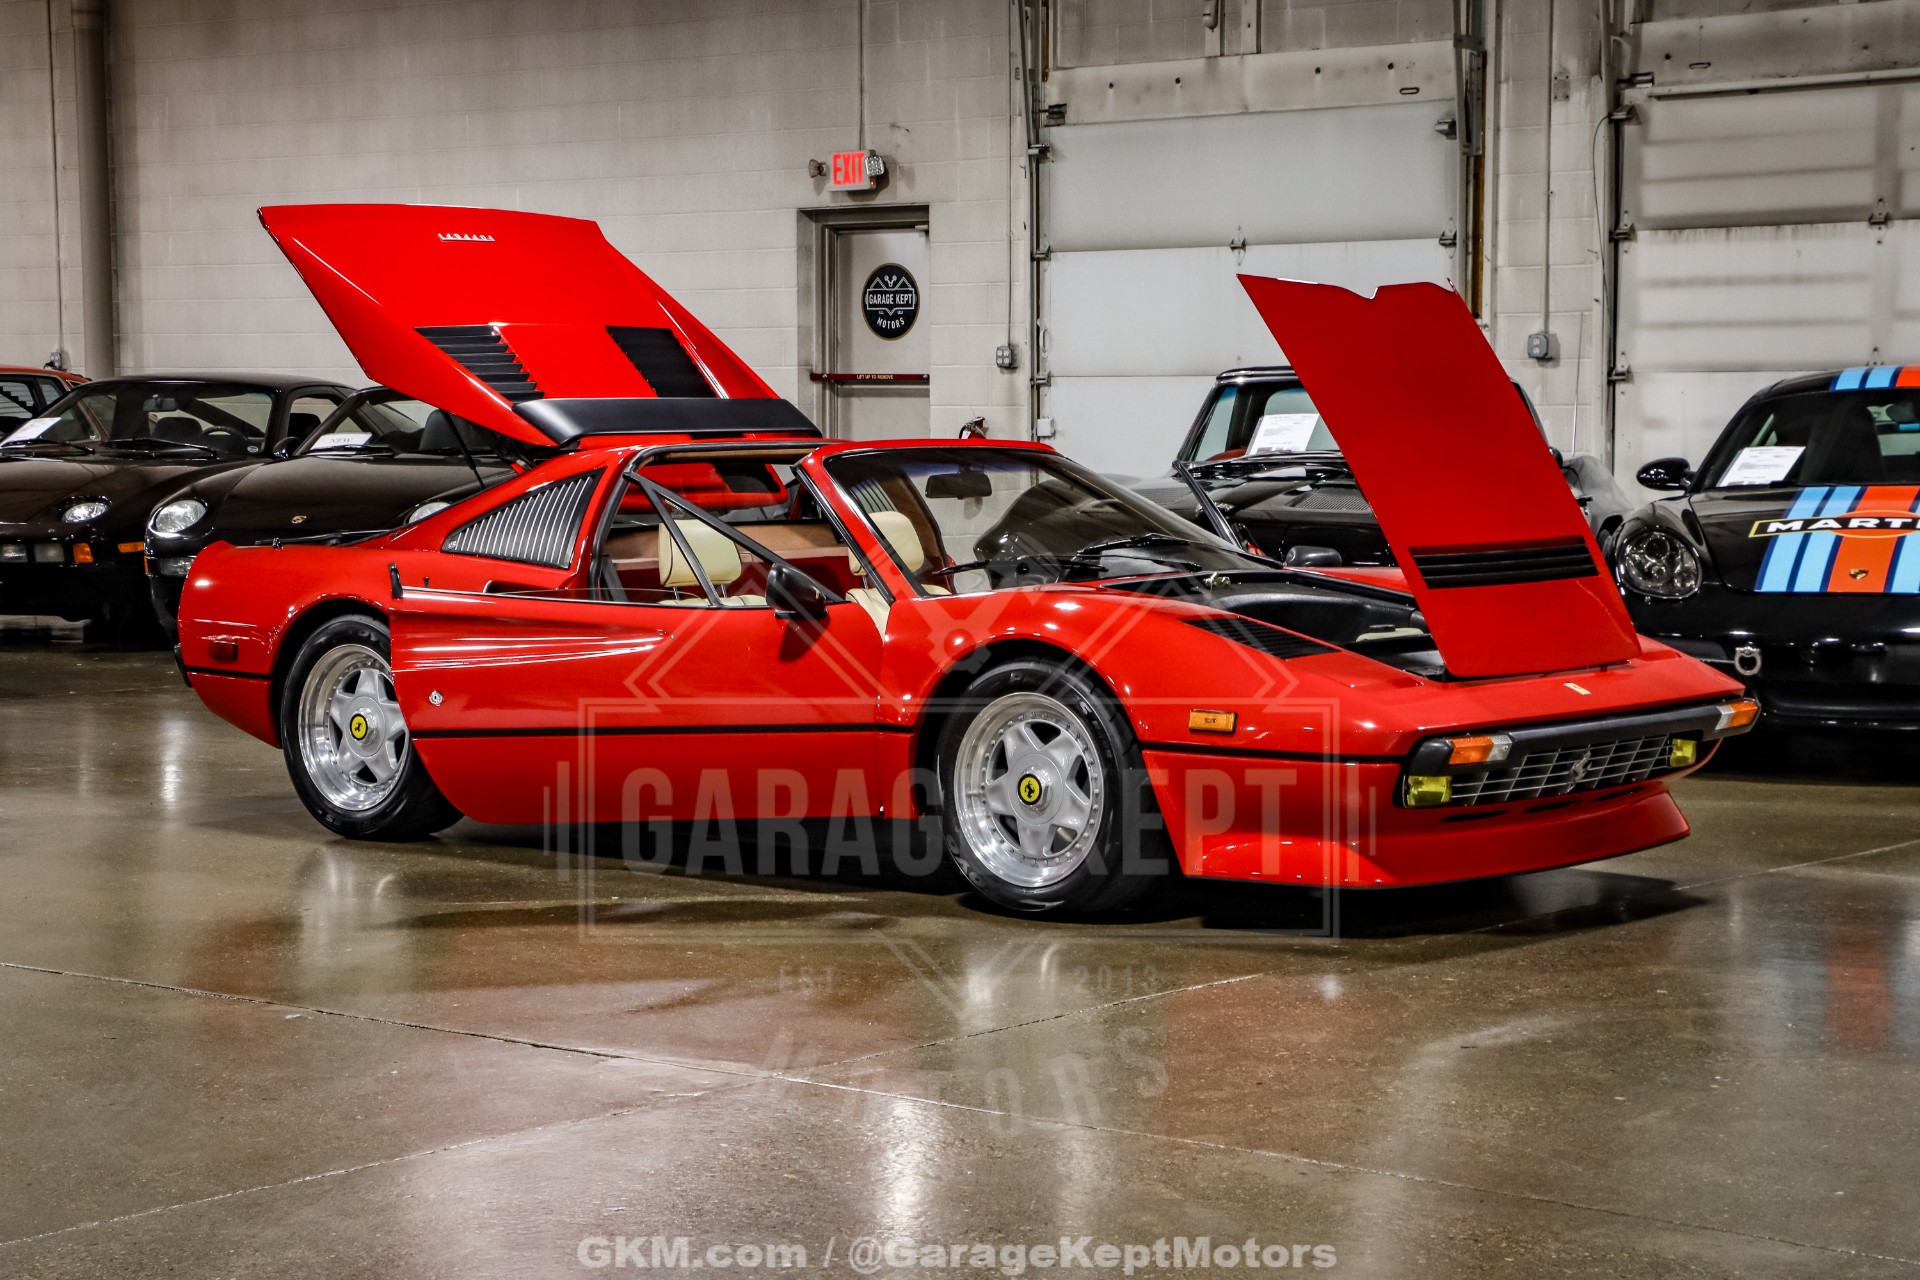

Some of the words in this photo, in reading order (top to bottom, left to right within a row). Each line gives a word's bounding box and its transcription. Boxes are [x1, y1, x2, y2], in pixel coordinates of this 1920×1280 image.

[832, 151, 865, 185] EXIT
[869, 293, 894, 305] GARAGE
[895, 293, 913, 305] KEPT
[876, 316, 905, 330] MOTORS
